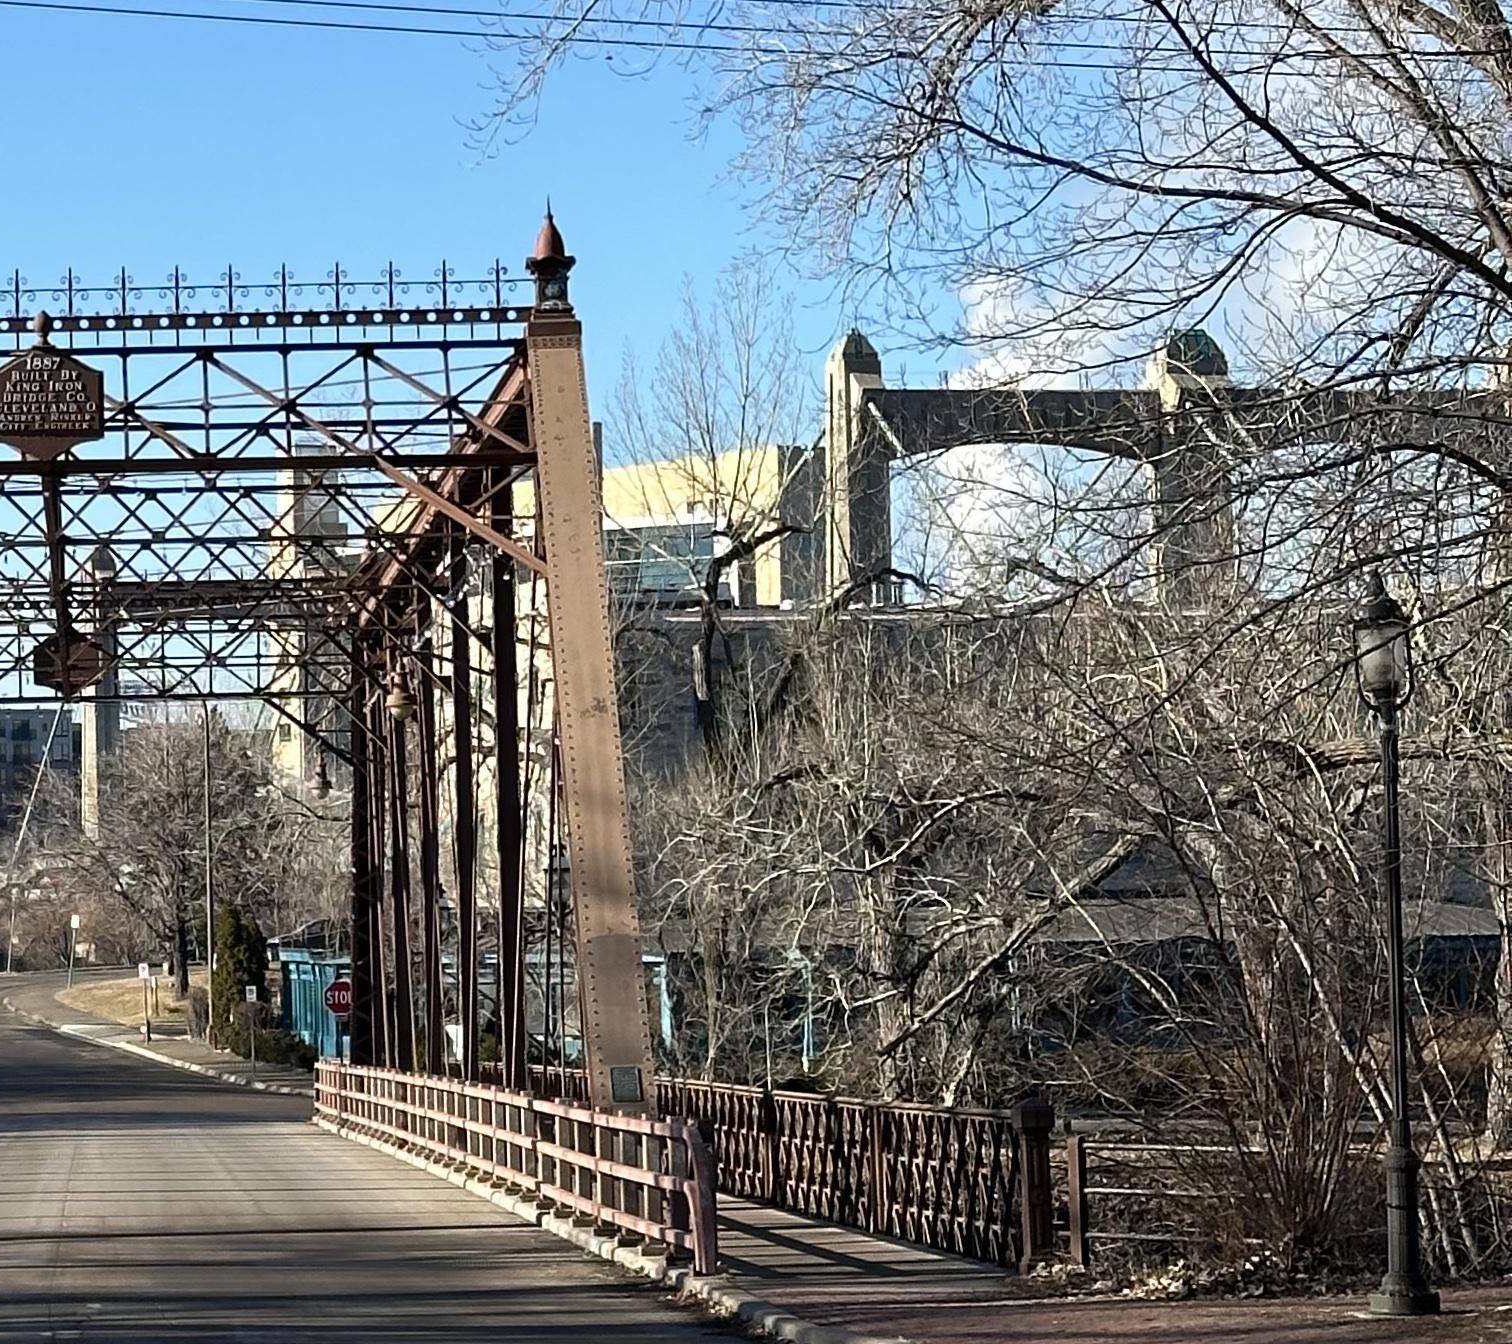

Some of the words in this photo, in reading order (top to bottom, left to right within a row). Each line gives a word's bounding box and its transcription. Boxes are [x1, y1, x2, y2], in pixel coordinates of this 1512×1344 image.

[25, 357, 61, 370] 1887
[11, 370, 49, 381] BUILT
[5, 381, 40, 392] KING
[49, 380, 83, 392] IRON
[3, 392, 57, 403] BRIDGE
